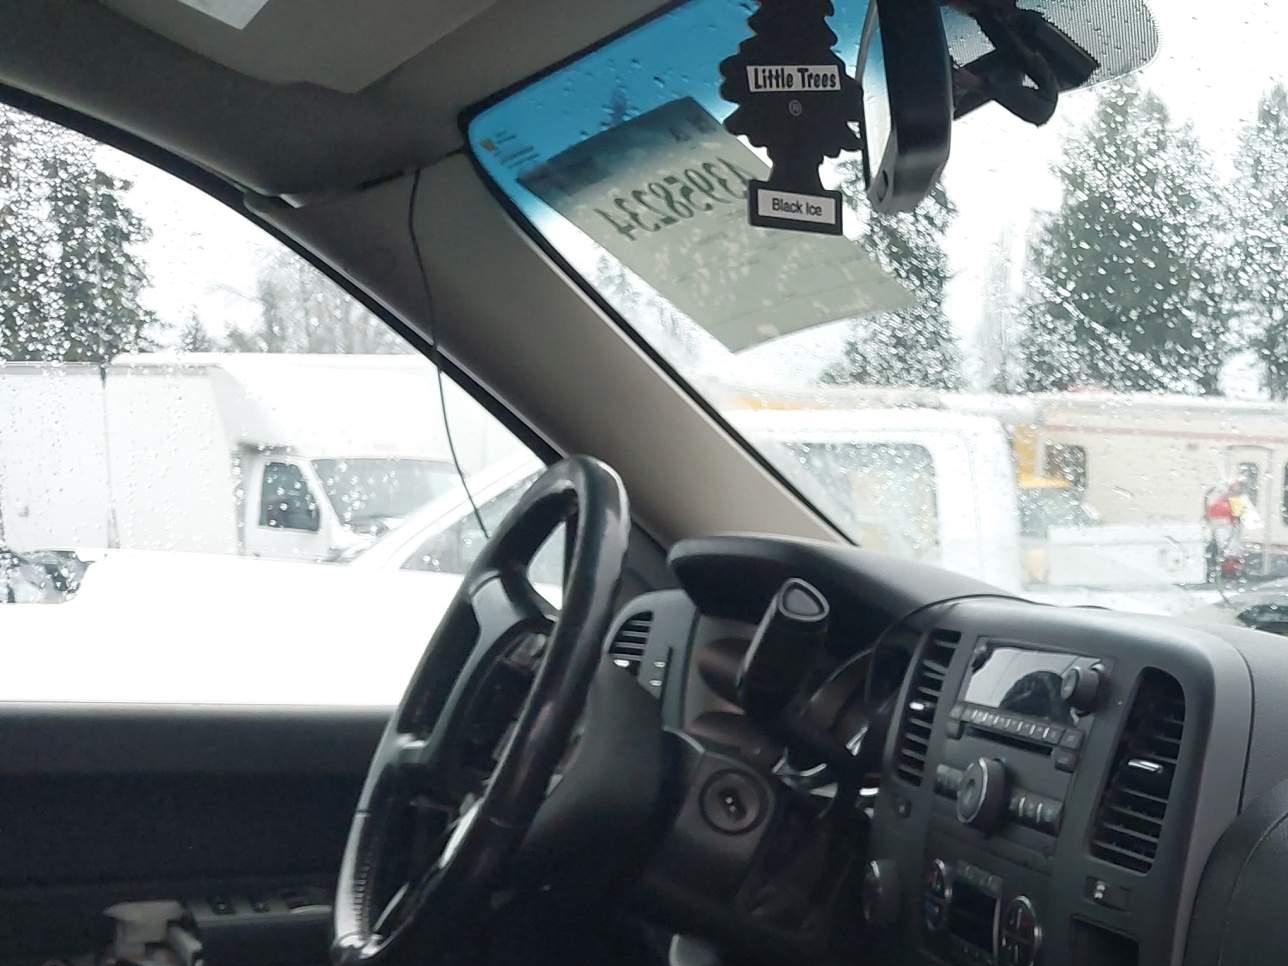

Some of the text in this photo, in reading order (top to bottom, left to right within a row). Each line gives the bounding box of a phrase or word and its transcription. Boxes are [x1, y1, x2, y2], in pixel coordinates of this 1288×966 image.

[753, 67, 837, 89] Little Trees
[771, 197, 823, 217] Black Ice
